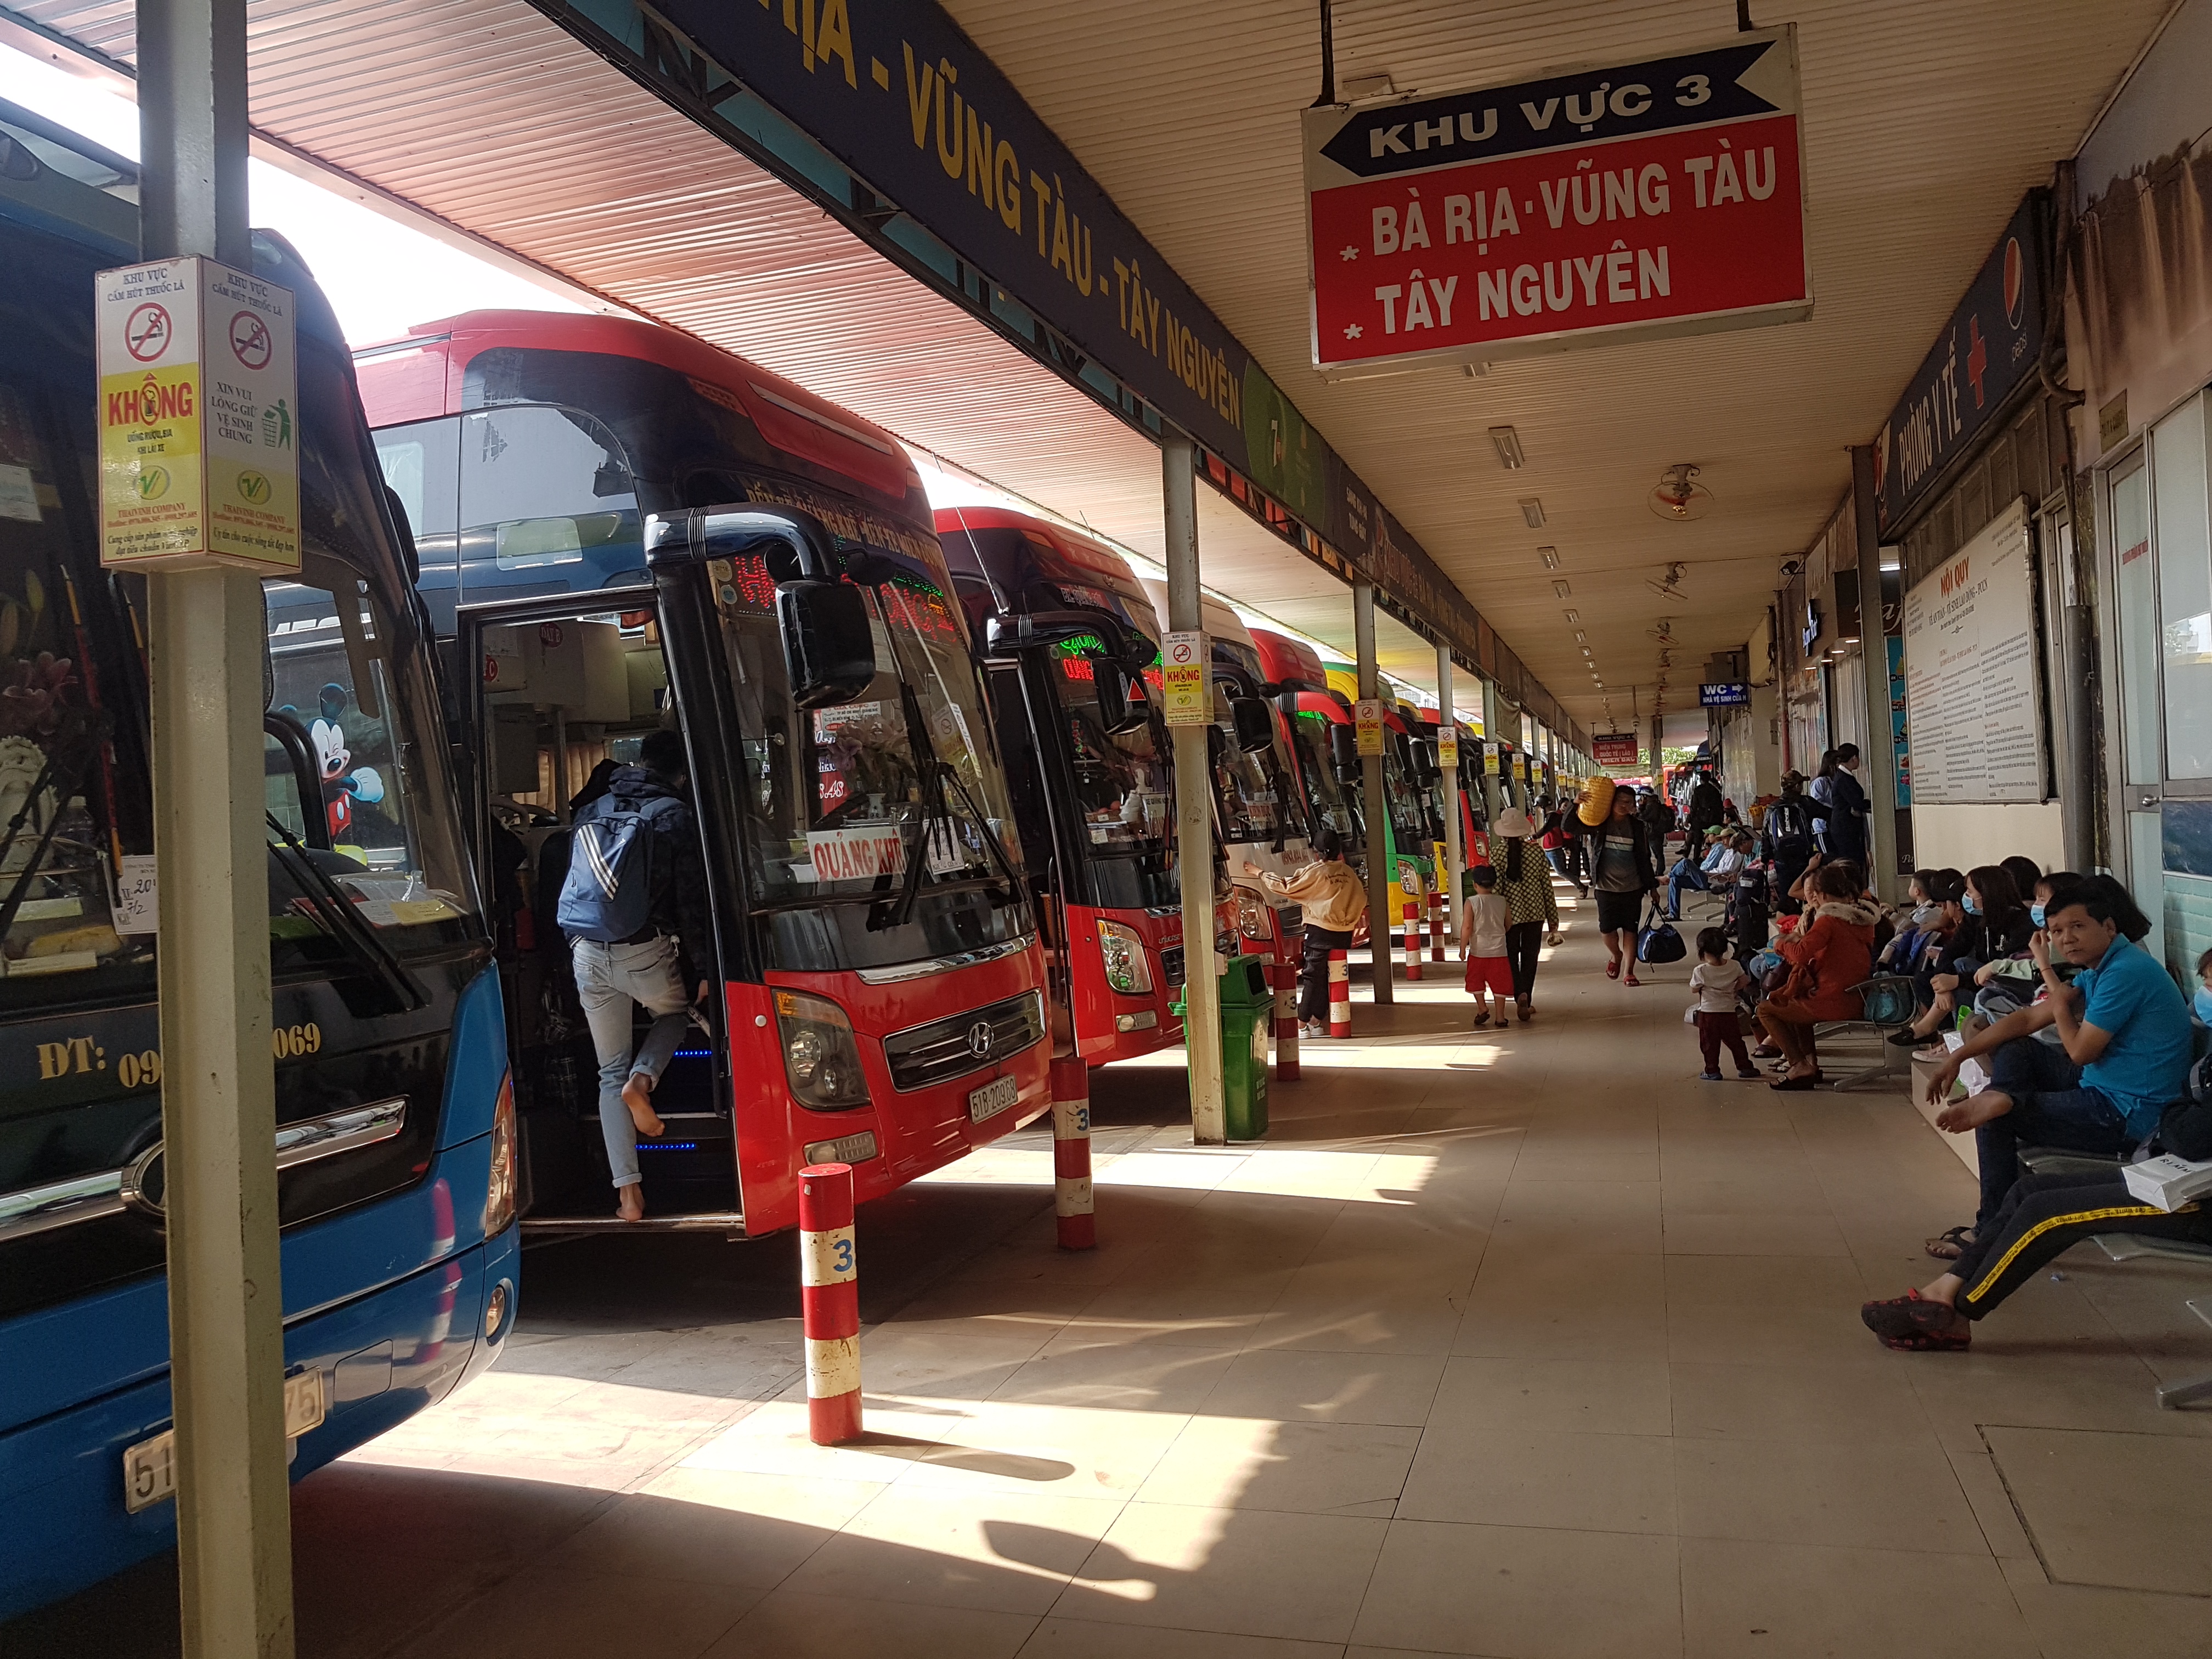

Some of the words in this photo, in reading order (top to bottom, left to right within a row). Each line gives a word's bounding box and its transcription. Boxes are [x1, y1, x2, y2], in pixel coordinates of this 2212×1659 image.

[1369, 107, 1498, 158] KHU
[1519, 81, 1653, 132] VỰC
[1675, 75, 1712, 106] 3
[1372, 187, 1431, 256] BÀ
[1684, 139, 1776, 209] TÀU
[903, 40, 1021, 236] VŨNG
[1030, 170, 1092, 297] TÀU
[1114, 255, 1171, 357] TÂY
[1166, 308, 1240, 431] NGUYÊN
[123, 272, 144, 285] KHU
[147, 267, 167, 283] VỰC
[228, 273, 247, 289] KHU
[250, 281, 268, 297] VỰC
[1375, 269, 1458, 334] TÂY
[1478, 241, 1671, 321] NGUYÊN
[145, 281, 171, 295] THUỐC
[108, 373, 193, 426] KHÔNG
[217, 382, 233, 395] XIN
[235, 387, 252, 401] VUI
[212, 396, 238, 413] LÒNG
[240, 404, 258, 417] GIỮ
[1899, 402, 1932, 496] PHÒNG
[1932, 379, 1942, 453] Y
[1942, 326, 1961, 441] TẾ
[217, 413, 230, 427] VỆ
[232, 416, 253, 431] SINH
[218, 427, 252, 444] CHUNG
[1940, 567, 1953, 599] NỘI
[1955, 556, 1970, 590] QUY
[1167, 666, 1200, 682] KHÔNG
[1703, 684, 1727, 695] WC
[1358, 720, 1379, 730] KHÔNG
[814, 832, 873, 878] QUẢNG
[1341, 964, 1348, 976] 3
[972, 1078, 1015, 1118] 51B-209.68
[1077, 1108, 1089, 1131] 3
[833, 1239, 853, 1272] 3
